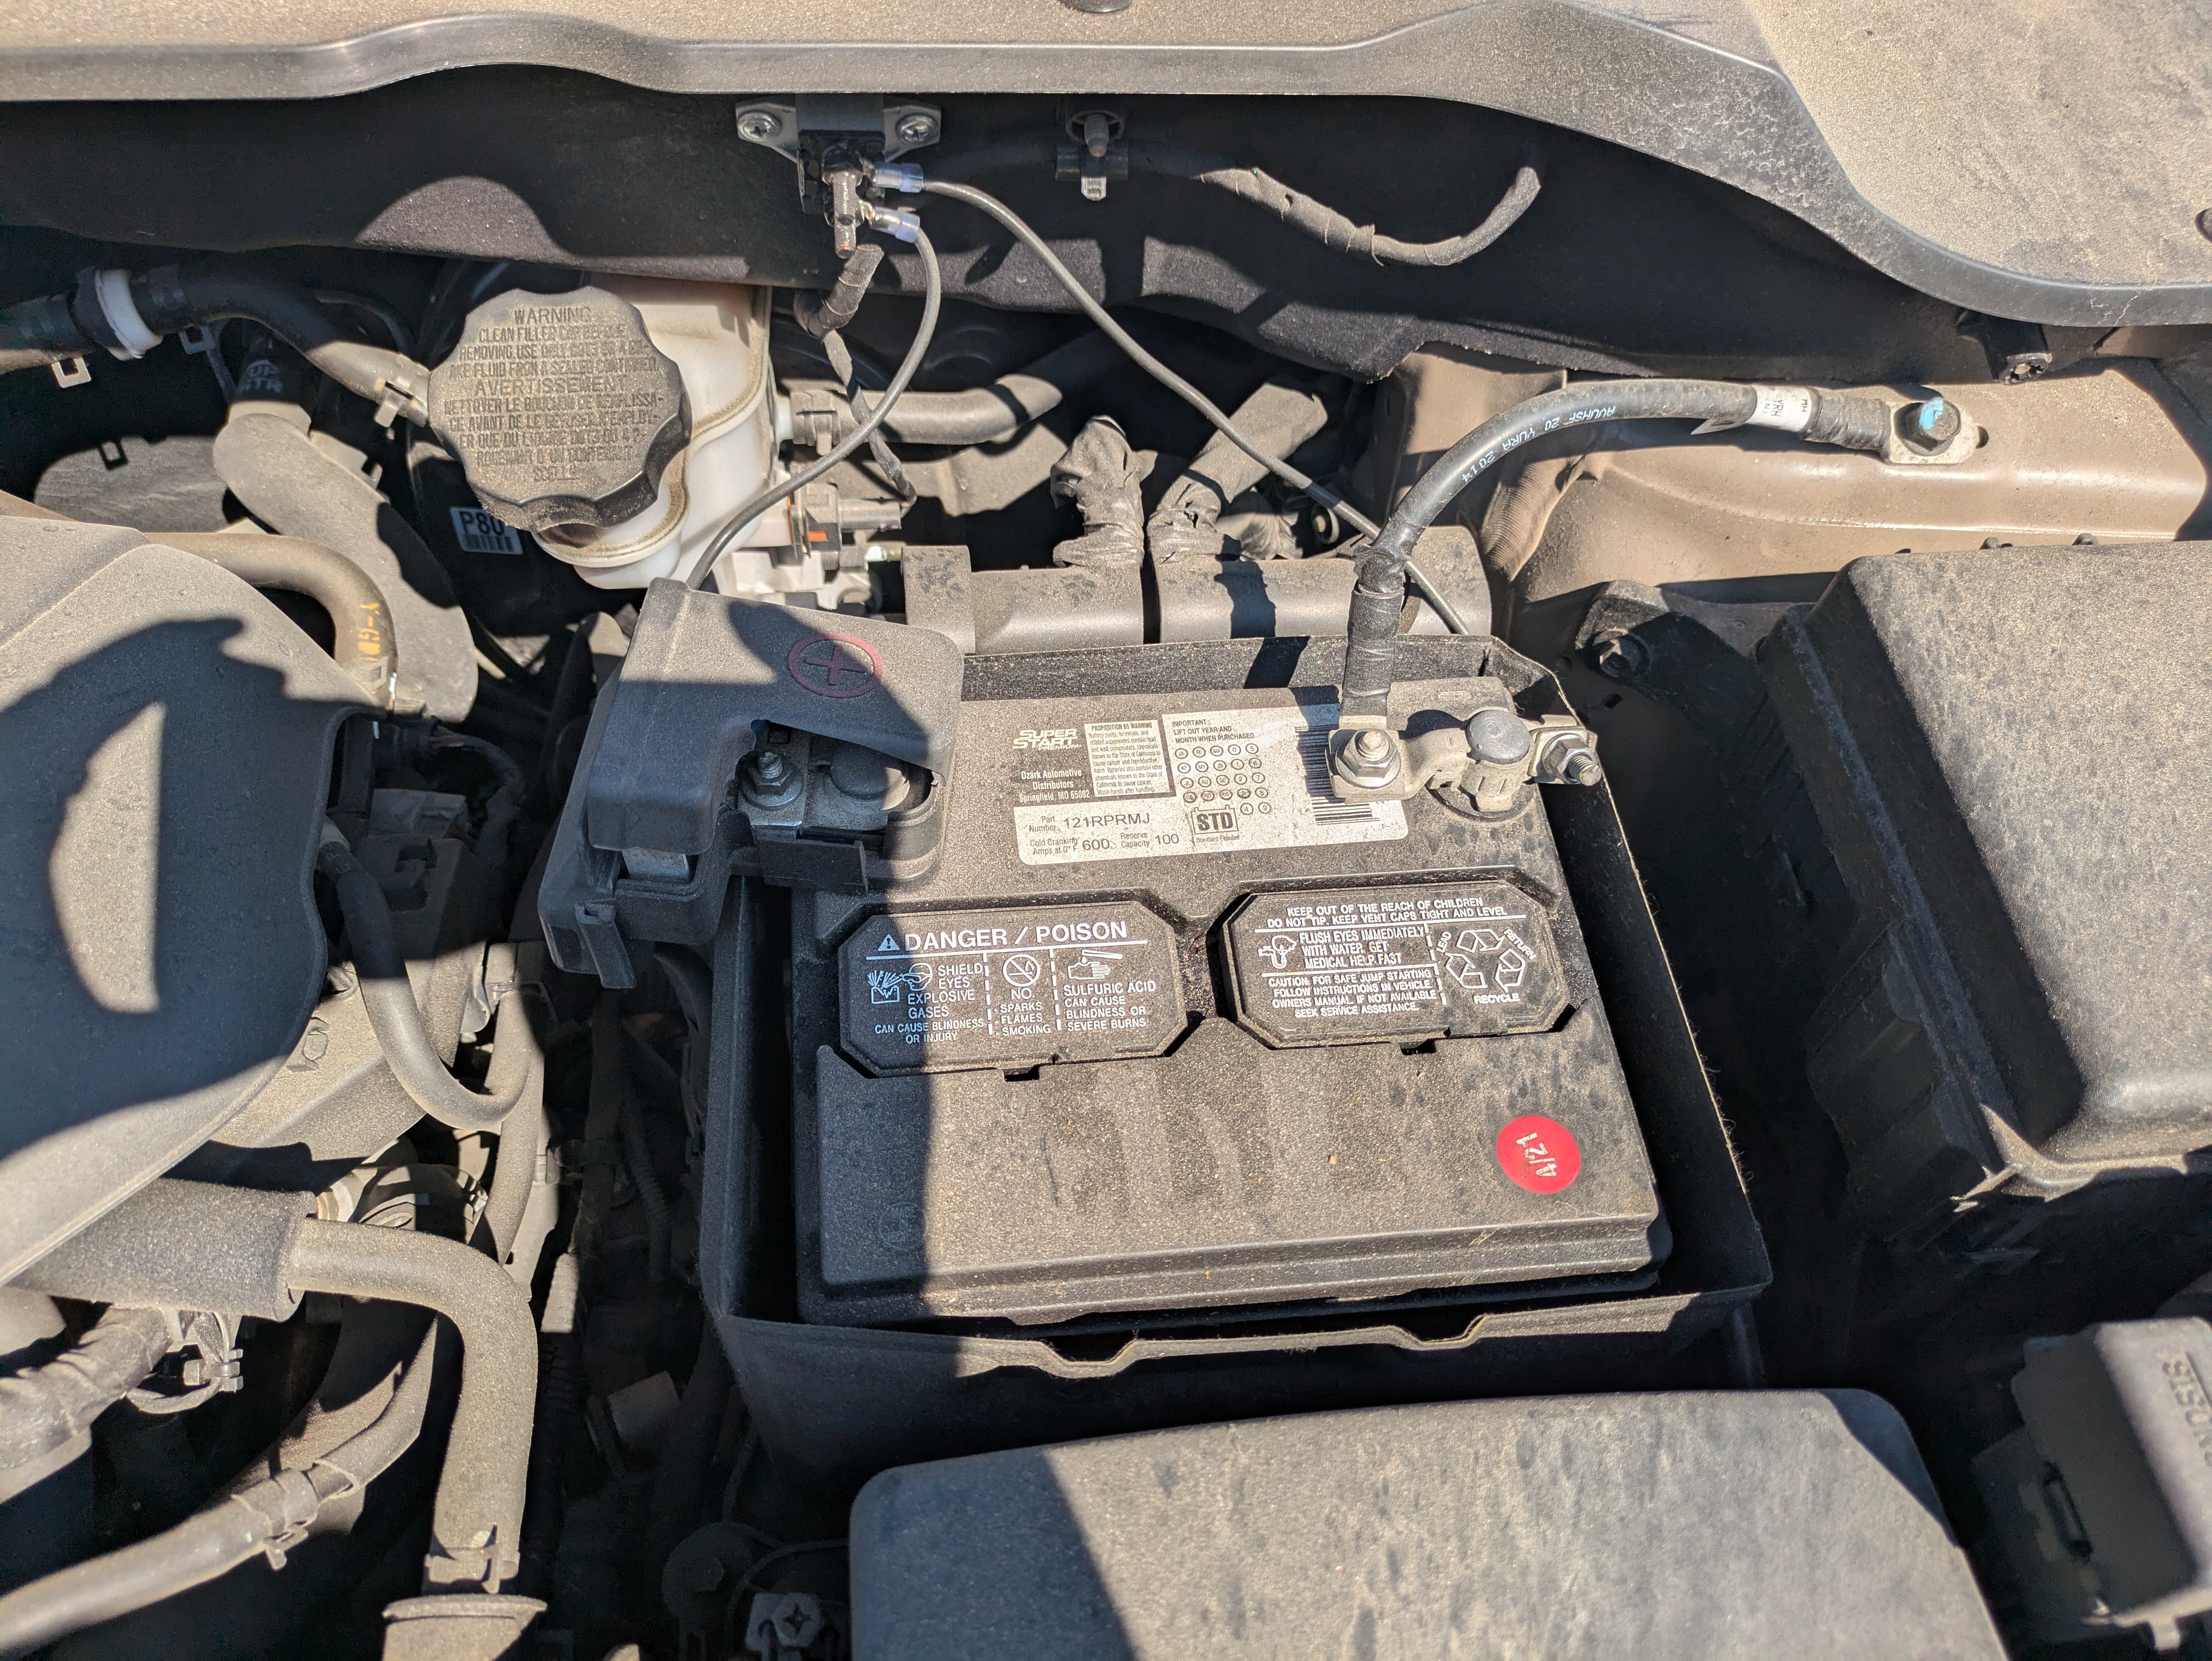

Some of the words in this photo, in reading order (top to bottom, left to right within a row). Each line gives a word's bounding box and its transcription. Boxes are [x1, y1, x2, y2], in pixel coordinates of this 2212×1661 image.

[515, 306, 591, 324] WARNING
[480, 327, 515, 342] CLEAN
[517, 344, 537, 359] USE
[476, 375, 628, 396] AVERTISSEMENT
[506, 398, 521, 412] LE
[1770, 400, 1783, 416] YRH
[1801, 399, 1808, 412] MH
[469, 415, 503, 431] AVANT
[1545, 417, 1559, 431] 20
[1462, 451, 1495, 482] 2014
[1019, 729, 1077, 739] SUPER
[1012, 736, 1077, 749] START
[1021, 770, 1041, 780] Ozark
[1043, 768, 1082, 778] Automotive
[1033, 781, 1074, 790] Distributors
[1019, 792, 1056, 803] Springfield,
[1058, 791, 1069, 800] MO
[1071, 790, 1090, 799] 65802
[1029, 824, 1056, 832] Number
[1064, 813, 1150, 829] 121RPRMJ
[1196, 812, 1234, 830] STD
[1048, 837, 1078, 846] Cranking
[1083, 839, 1110, 851] 600
[1121, 840, 1150, 849] Capacity
[1155, 833, 1180, 845] 100
[1287, 907, 1313, 917] KEEP
[1316, 906, 1337, 916] OUT
[1340, 904, 1354, 914] OF
[1357, 903, 1377, 913] THE
[1381, 901, 1414, 912] REACH
[1417, 900, 1430, 910] OF
[1434, 897, 1483, 909] CHILDREN
[1267, 918, 1283, 928] DO
[1285, 917, 1306, 927] NOT
[1311, 916, 1329, 926] TIP.
[1332, 915, 1358, 925] KEEP
[1360, 913, 1386, 923] VENT
[1390, 911, 1417, 922] CAPS
[1420, 909, 1449, 920] TIGHT
[1453, 908, 1474, 918] AND
[1478, 907, 1507, 916] LEVEL
[905, 929, 1007, 951] DANGER
[1014, 927, 1028, 944] /
[1036, 921, 1127, 943] POISON
[1299, 931, 1331, 944] FLUSH
[1333, 930, 1359, 942] EYES
[1361, 926, 1425, 941] IMMEDIATELY
[1436, 931, 1451, 953] LEAD
[1301, 944, 1327, 957] WITH
[1369, 941, 1387, 953] GET
[1504, 929, 1537, 960] RETURN
[1304, 957, 1348, 969] MEDICAL
[1349, 955, 1374, 967] HELP
[1378, 952, 1401, 965] FAST
[938, 963, 983, 976] SHIELD
[939, 977, 970, 989] EYES
[1268, 977, 1310, 987] CAUTION:
[1312, 975, 1331, 985] FOR
[1334, 974, 1357, 984] SAFE
[1360, 973, 1383, 983] JUMP
[1387, 969, 1431, 981] STARTING
[1011, 988, 1031, 999] NO
[1063, 983, 1123, 996] SULFURIC
[1127, 980, 1156, 993] ACID
[1273, 987, 1311, 997] FOLLOW
[1313, 983, 1379, 996] INSTRUCTIONS
[1381, 983, 1391, 992] IN
[908, 989, 975, 1005] EXPLOSIVE
[1064, 998, 1086, 1008] CAN
[1091, 996, 1126, 1005] CAUSE
[1272, 998, 1312, 1008] OWNERS
[1356, 995, 1364, 1003] IF
[1368, 993, 1386, 1003] NOT
[1390, 990, 1437, 1001] AVAILABLE
[1473, 993, 1520, 1004] RECYCLE
[908, 1006, 949, 1019] GASES
[1000, 1001, 1042, 1013] SPARKS
[1066, 1007, 1125, 1019] BLINDNESS
[1130, 1006, 1146, 1016] OR
[1294, 1008, 1318, 1018] SEEK
[1320, 1006, 1359, 1017] SERVICE
[1361, 1002, 1419, 1014] ASSISTANCE.
[1001, 1013, 1042, 1024] FLAMES
[1067, 1020, 1107, 1031] SEVERE
[1111, 1018, 1146, 1029] BURNS
[875, 1024, 894, 1034] CAN
[898, 1023, 929, 1032] CAUSE
[932, 1019, 984, 1031] BLINDNESS
[1002, 1025, 1051, 1036] SMOKING
[906, 1034, 920, 1044] OR
[924, 1032, 957, 1042] INJURY
